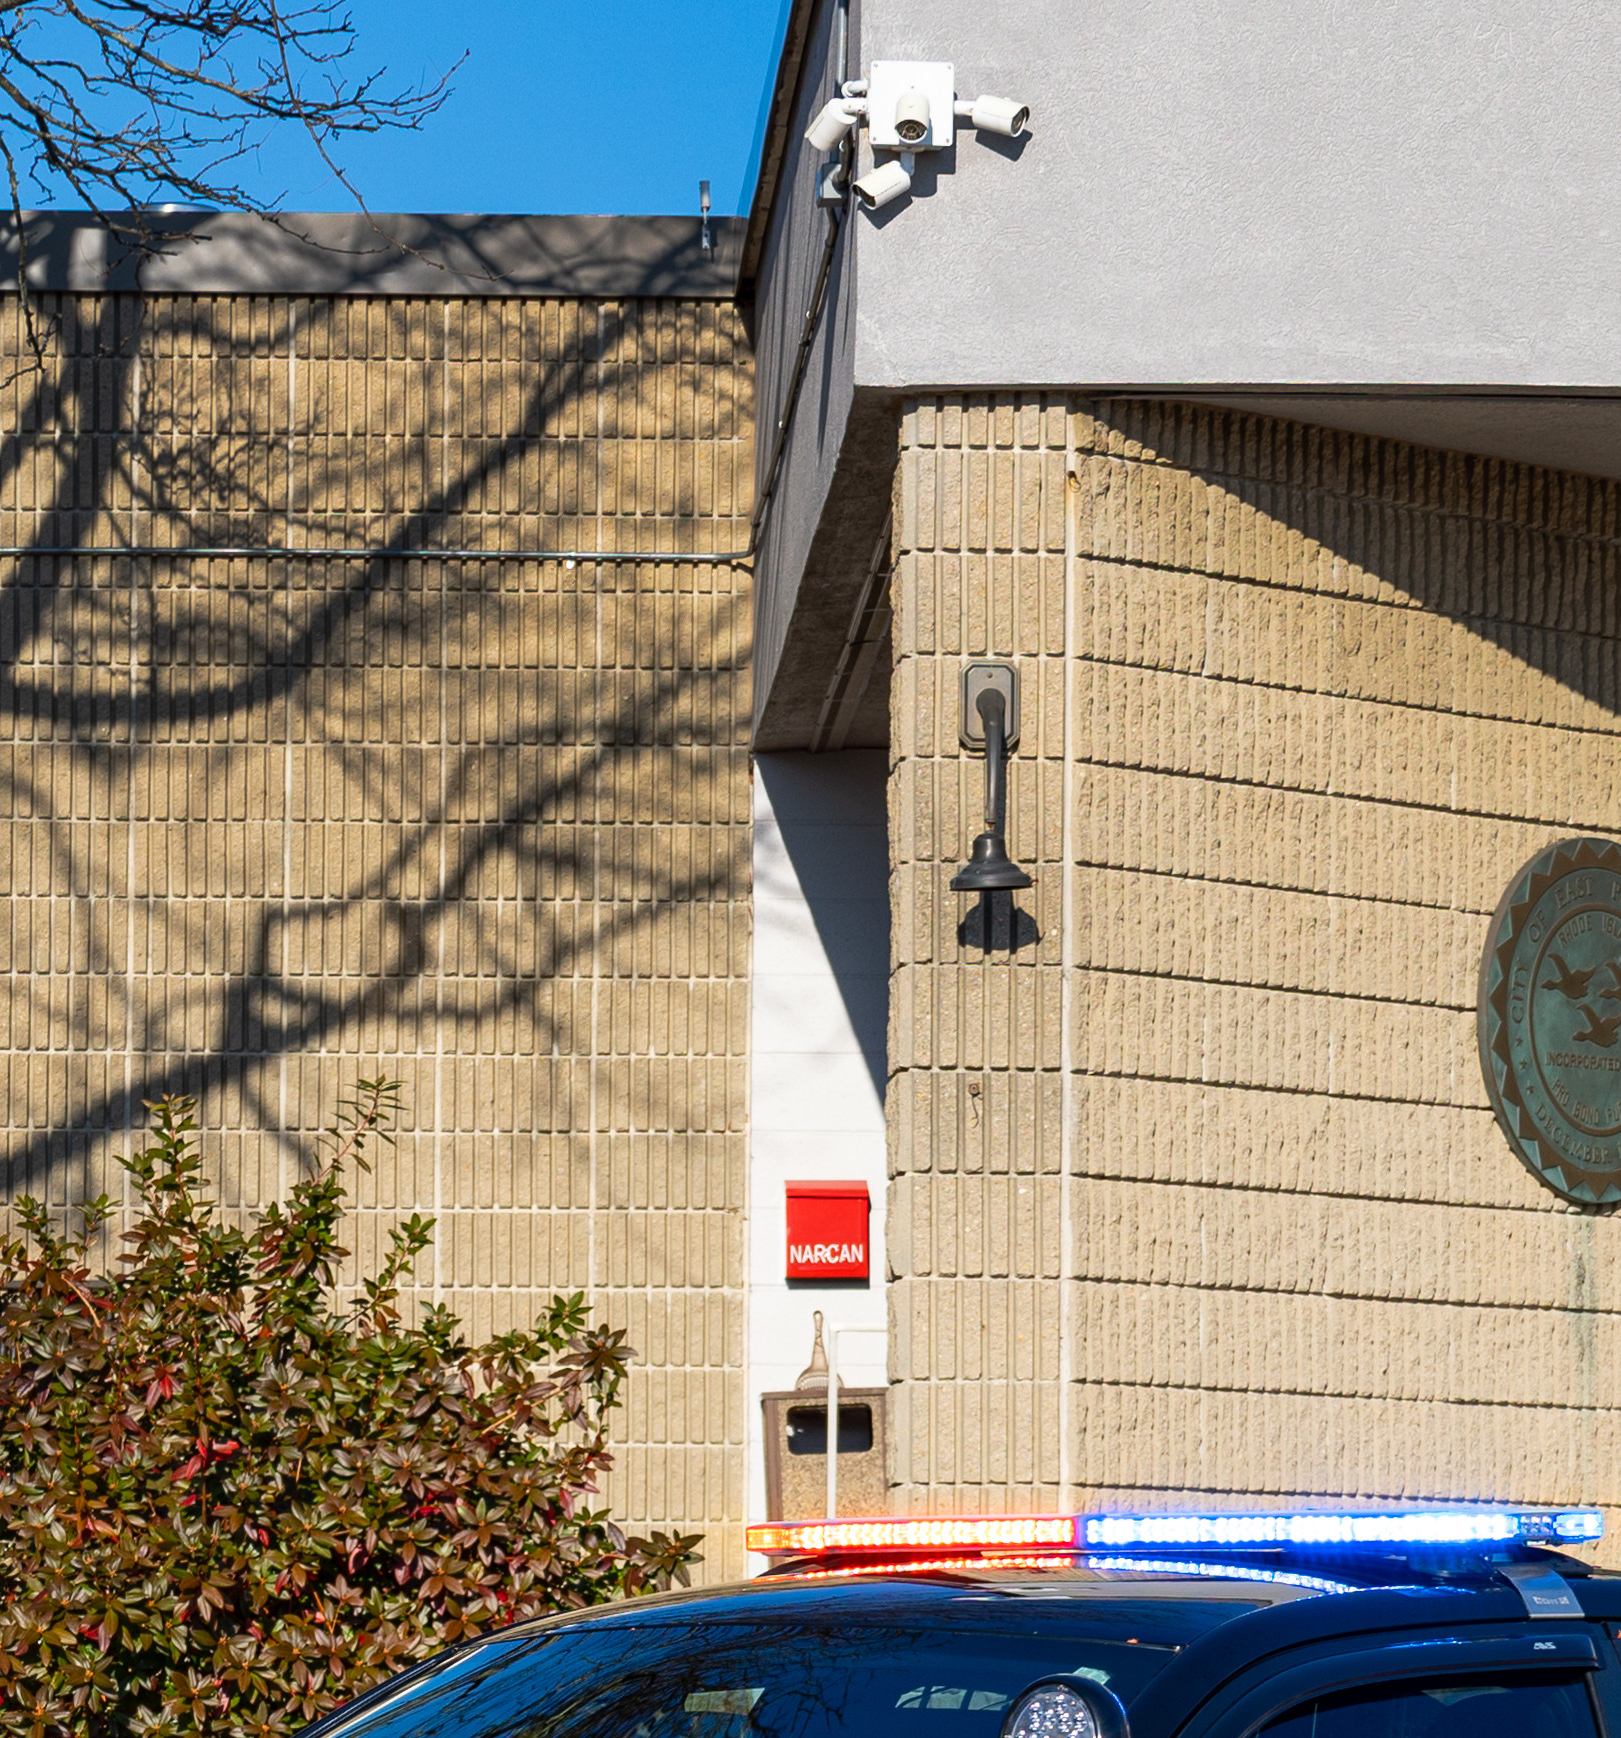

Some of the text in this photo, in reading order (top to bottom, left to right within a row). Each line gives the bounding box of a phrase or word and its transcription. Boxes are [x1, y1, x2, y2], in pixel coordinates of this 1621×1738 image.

[1558, 914, 1592, 948] RHODE
[1511, 963, 1528, 1025] CITY
[1529, 909, 1547, 943] OF
[1554, 876, 1594, 909] EAST
[1545, 1051, 1621, 1072] INCORPORATED
[1534, 1103, 1614, 1164] DECEMBER
[789, 1243, 864, 1265] NARCAN
